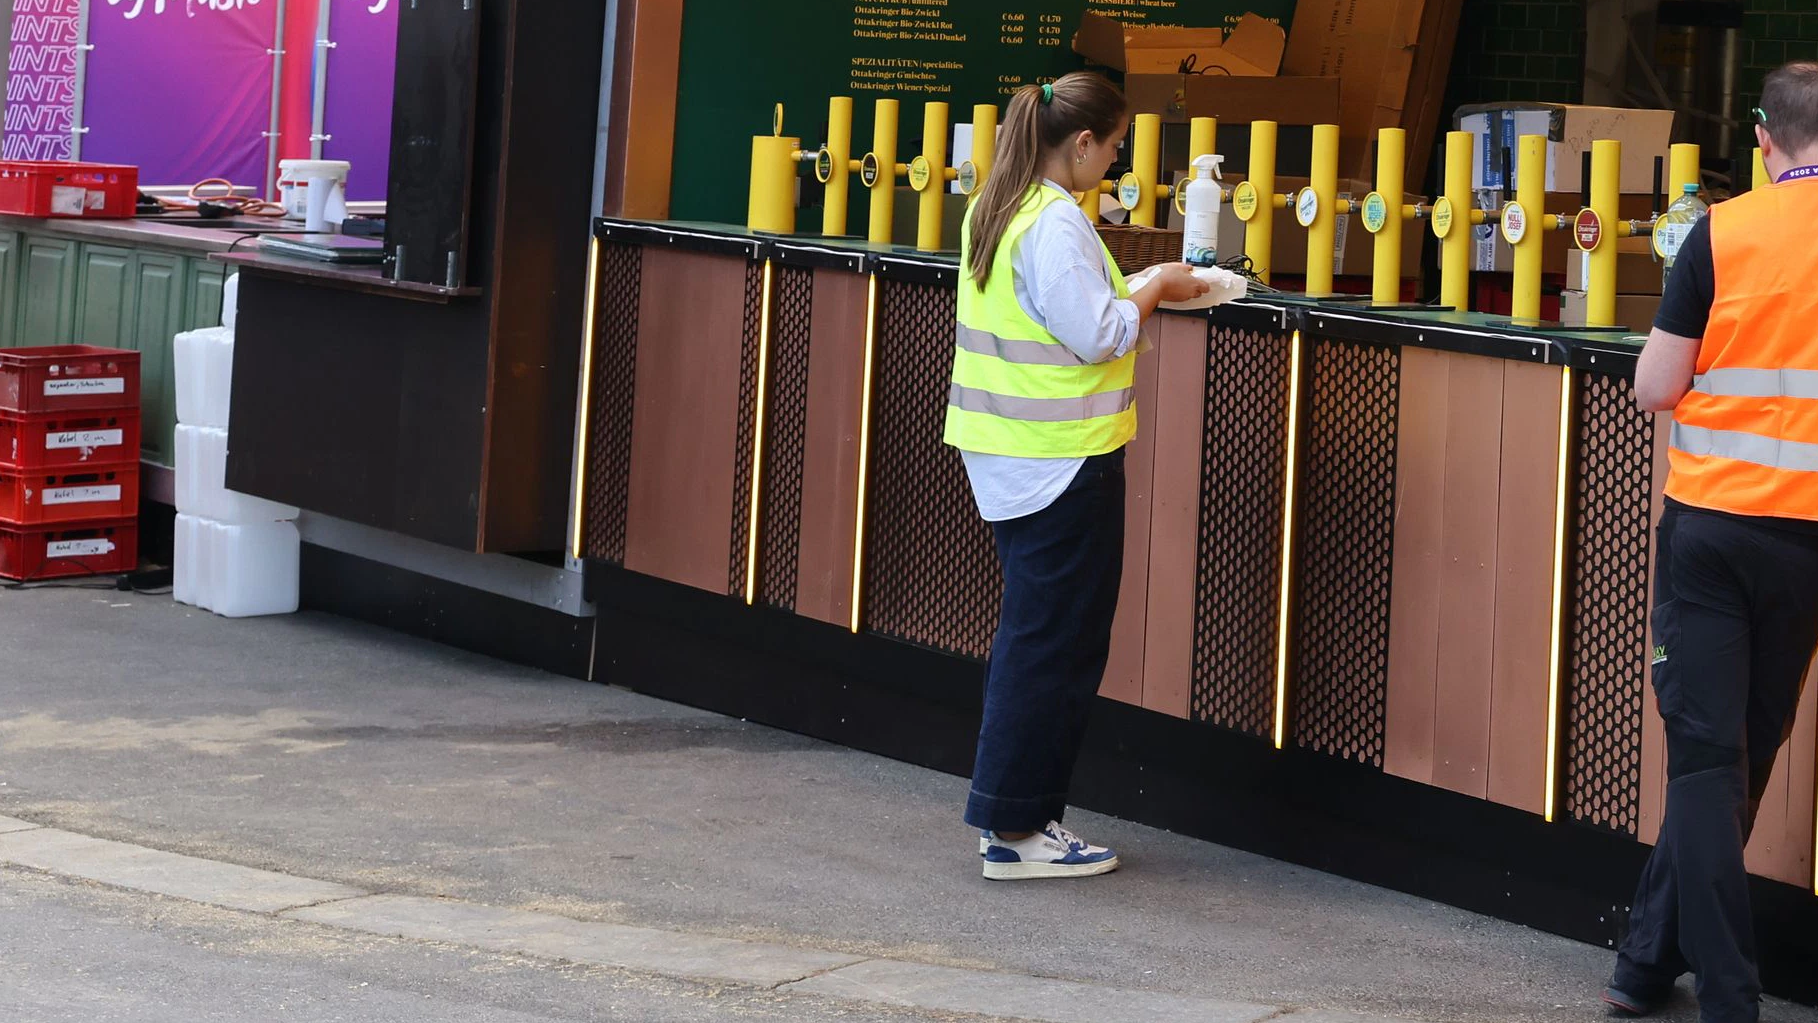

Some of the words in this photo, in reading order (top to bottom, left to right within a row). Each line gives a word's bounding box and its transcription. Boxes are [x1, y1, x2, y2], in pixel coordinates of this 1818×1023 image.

[1160, 0, 1176, 8] beer
[854, 6, 900, 18] Ottakringer
[10, 15, 80, 44] INTS
[854, 18, 899, 29] Ottakringer
[853, 30, 899, 41] Ottakringer
[940, 33, 967, 42] Dunkel
[8, 45, 77, 73] INTS
[852, 57, 919, 68] SPEZIALITÄTEN
[851, 70, 896, 80] Ottakringer
[6, 75, 76, 103] INTS
[850, 81, 895, 92] Ottakringer
[896, 83, 924, 92] Wiener
[924, 84, 951, 94] Spezial
[4, 105, 74, 133] INTS
[2, 135, 72, 161] INTS
[1790, 168, 1810, 178] 2026
